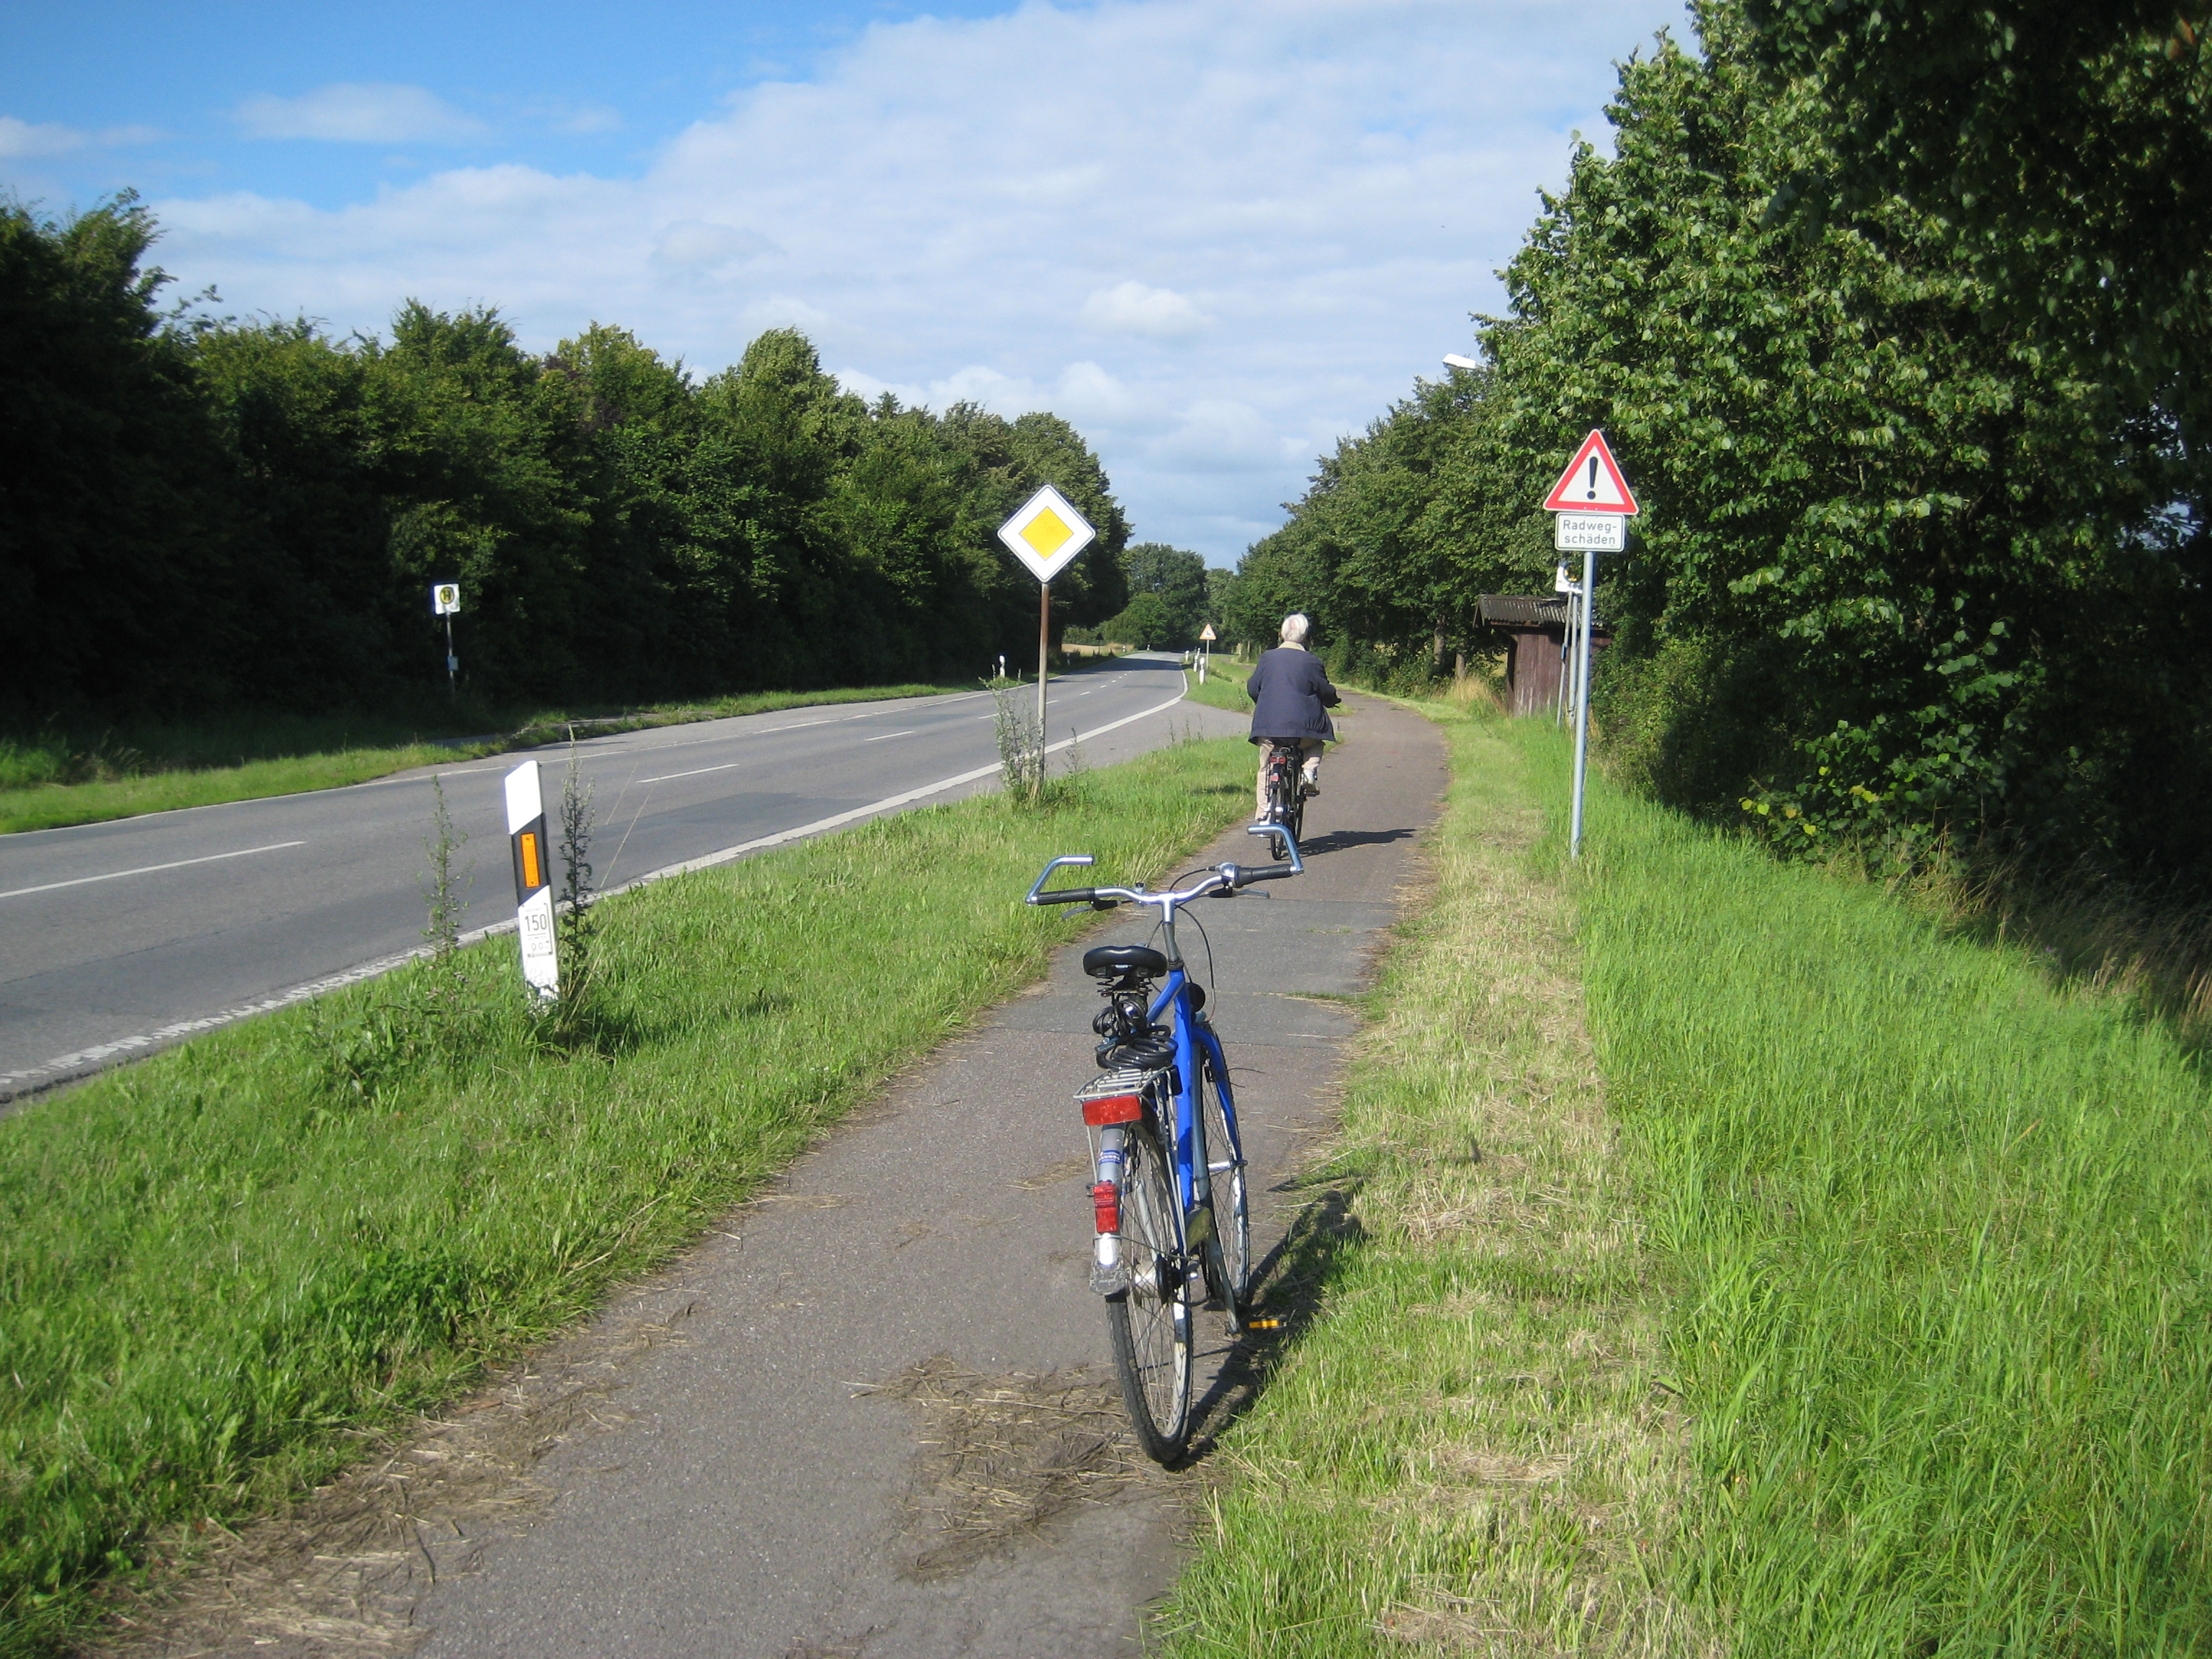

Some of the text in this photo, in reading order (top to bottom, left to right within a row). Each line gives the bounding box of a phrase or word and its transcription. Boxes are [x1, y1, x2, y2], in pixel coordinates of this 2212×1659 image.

[1563, 519, 1617, 534] Radweg-
[1564, 533, 1616, 544] schäden
[524, 914, 547, 932] 150
